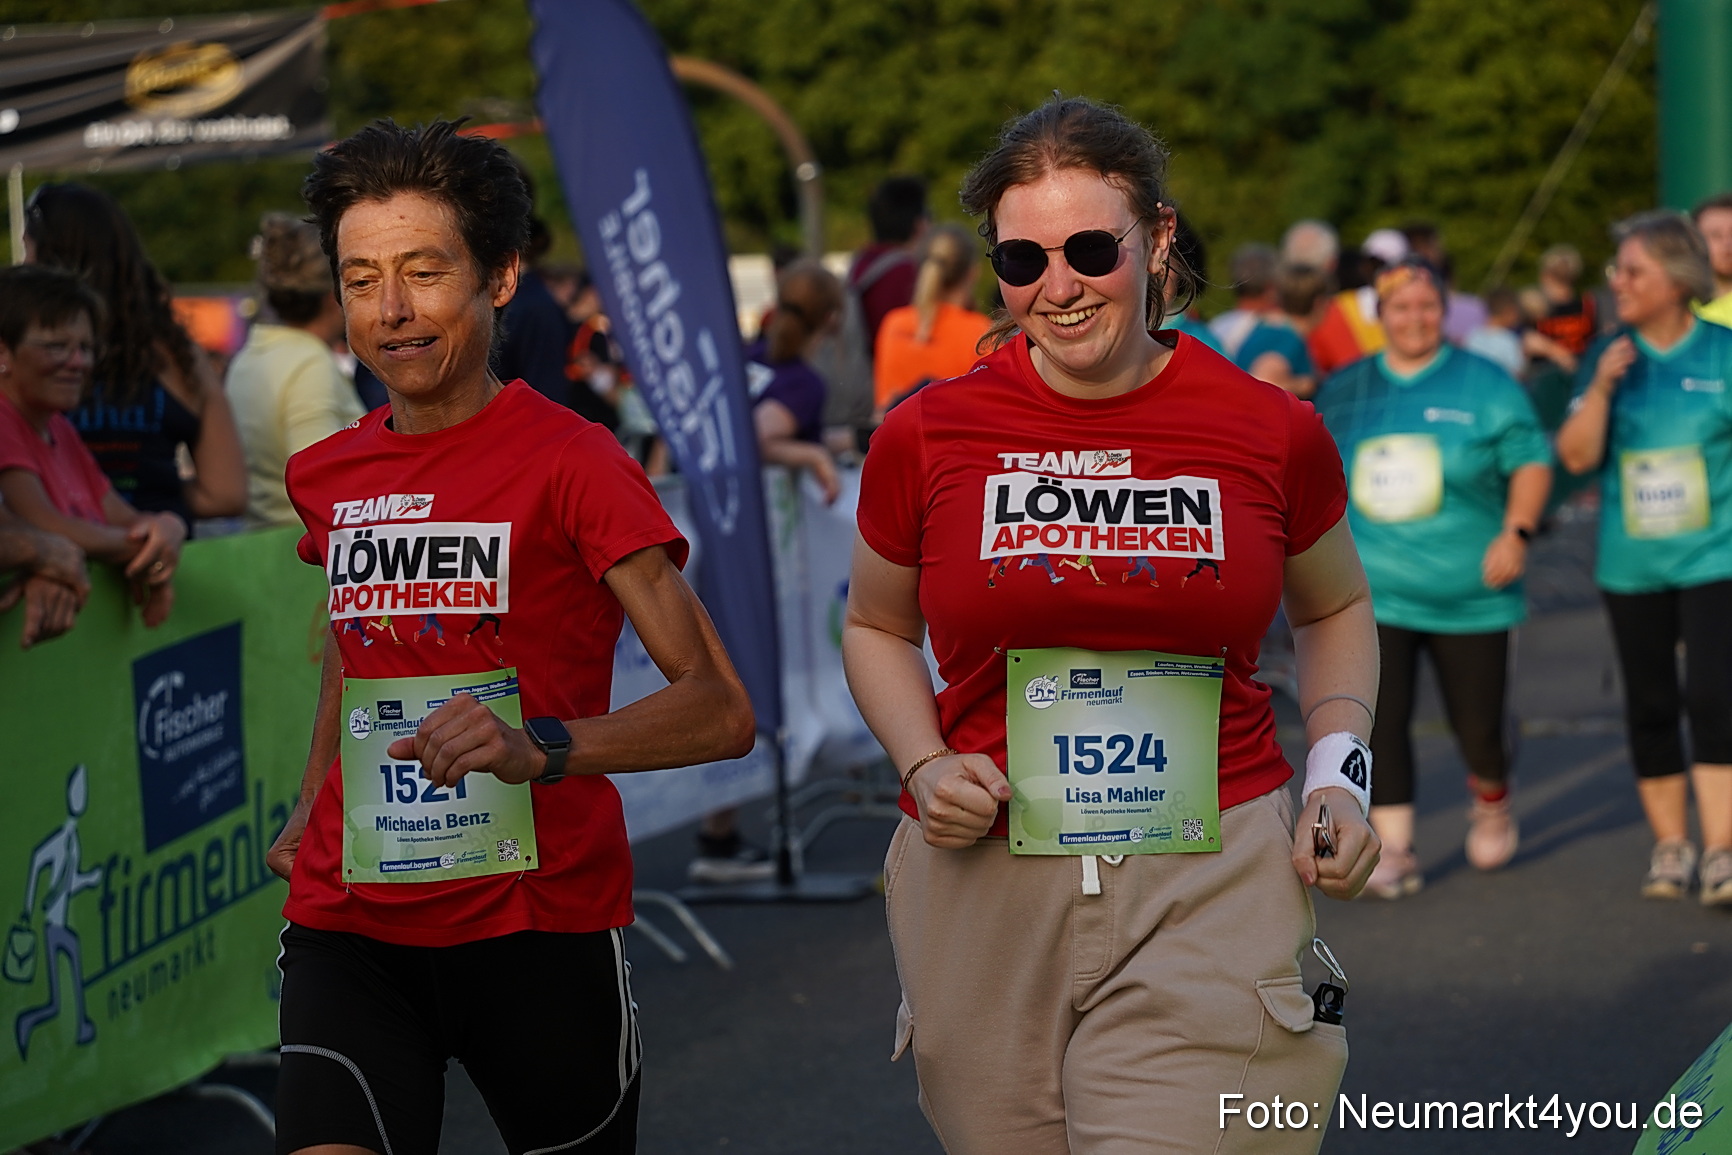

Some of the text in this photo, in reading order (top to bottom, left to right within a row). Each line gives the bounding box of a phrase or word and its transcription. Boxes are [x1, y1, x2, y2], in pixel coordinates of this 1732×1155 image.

[998, 451, 1092, 475] TEAM
[333, 495, 399, 526] TEAM
[994, 476, 1212, 525] LÖWEN
[991, 524, 1214, 553] APOTHEKEN
[331, 529, 500, 586] LÖWEN
[330, 581, 498, 614] APOTHEKEN
[1061, 686, 1123, 700] Firmenlauf
[1086, 697, 1122, 706] neumarkt
[155, 688, 228, 747] Fischer
[1053, 733, 1167, 775] 1524
[1065, 786, 1165, 803] Lisa Mahler
[375, 812, 490, 832] Michaela Benz
[435, 833, 463, 841] Neumarkt
[1062, 833, 1127, 843] firmenlauf.bayern
[382, 860, 438, 871] firmenlauf.bayern
[107, 926, 216, 1021] neumarkt
